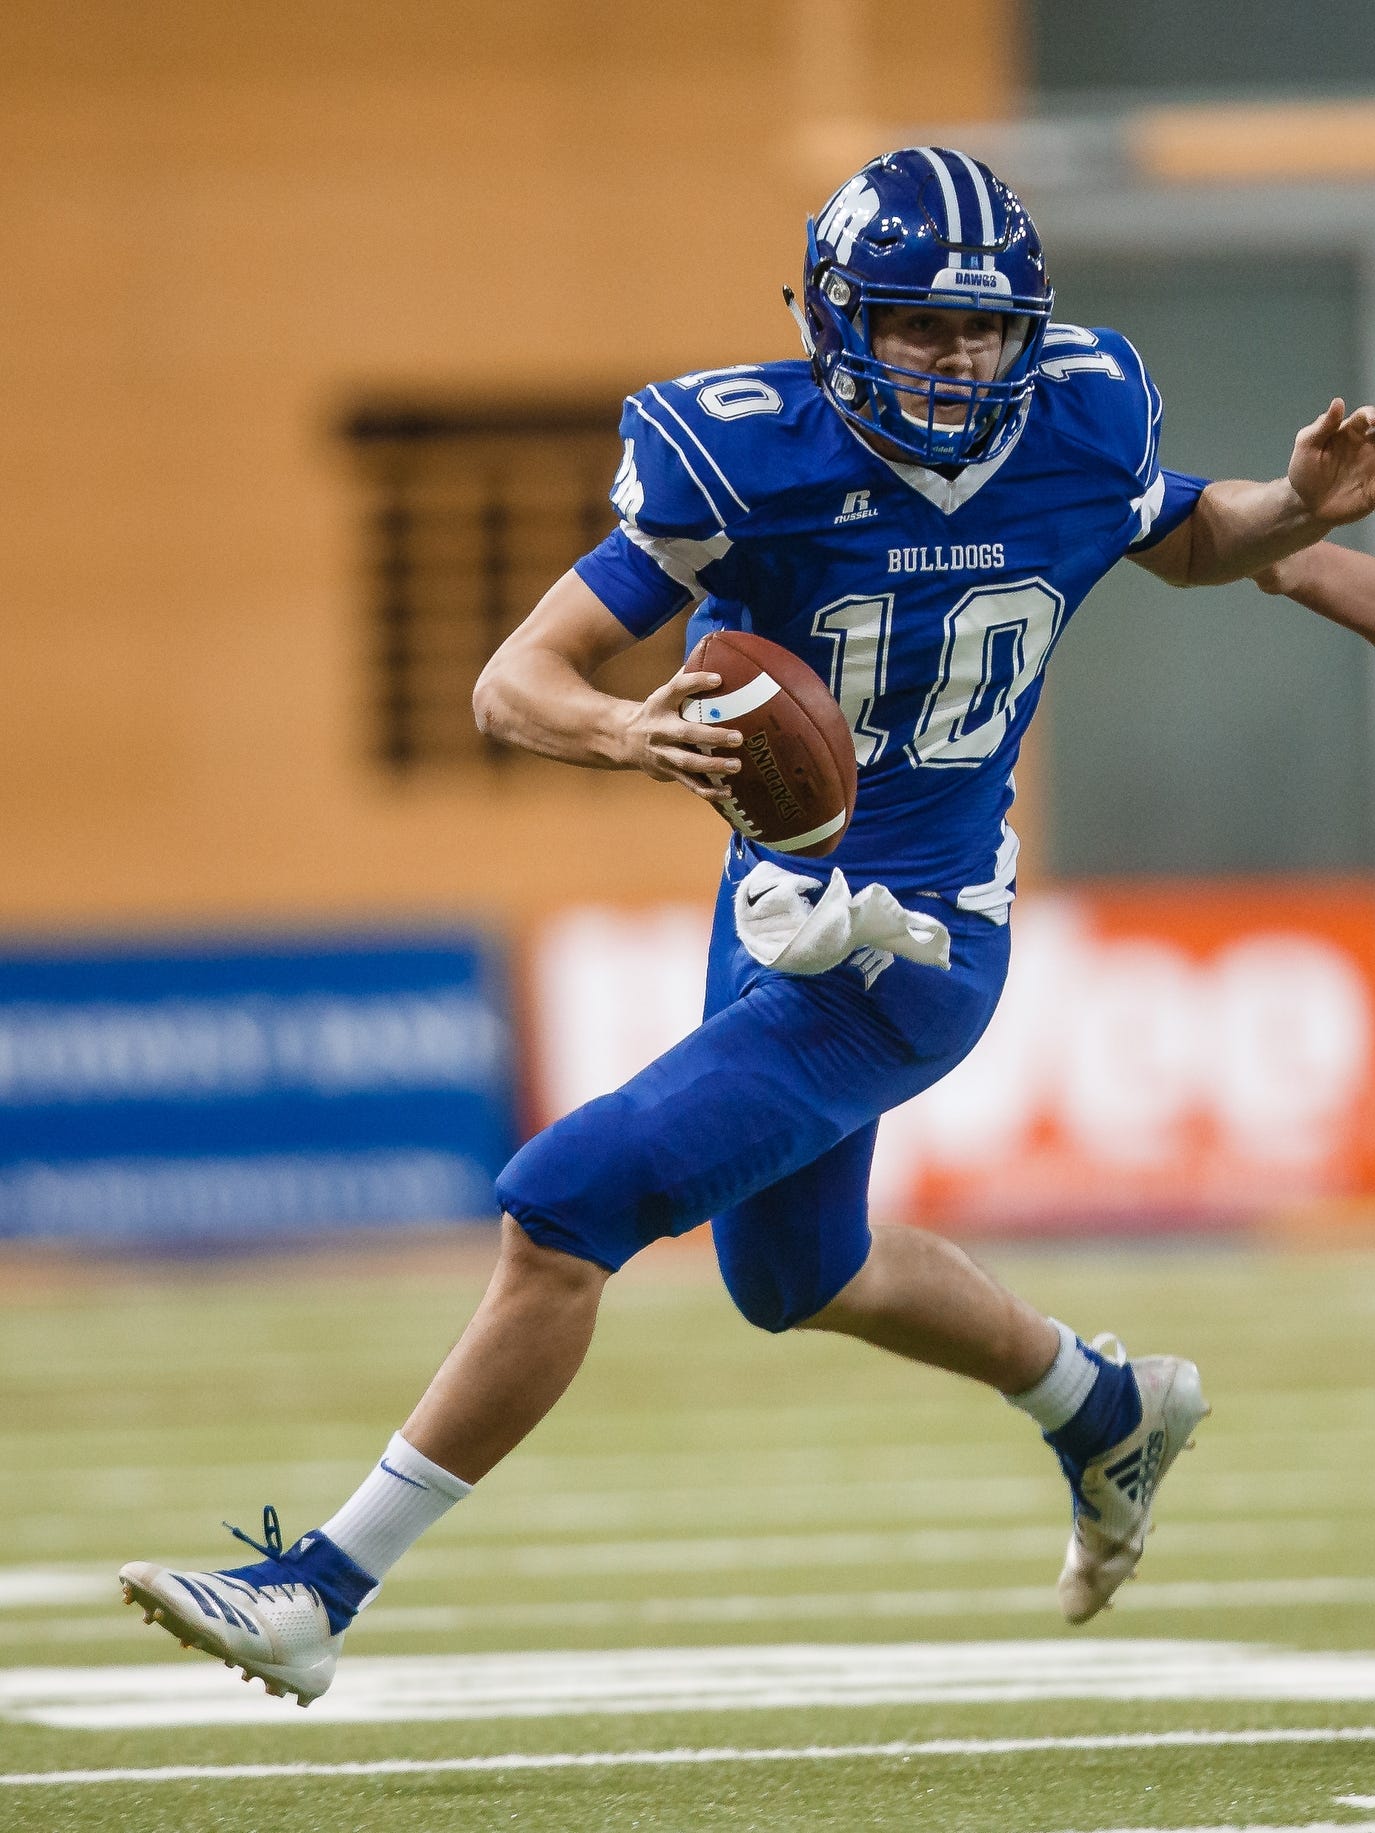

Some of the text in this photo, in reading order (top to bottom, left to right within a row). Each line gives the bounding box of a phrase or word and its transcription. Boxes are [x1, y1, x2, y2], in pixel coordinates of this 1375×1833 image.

[955, 271, 997, 288] DAWGS
[833, 508, 879, 525] RUSSELL
[887, 543, 1006, 573] BULLDOGS
[810, 575, 1066, 769] 10
[744, 729, 807, 823] SPALDING
